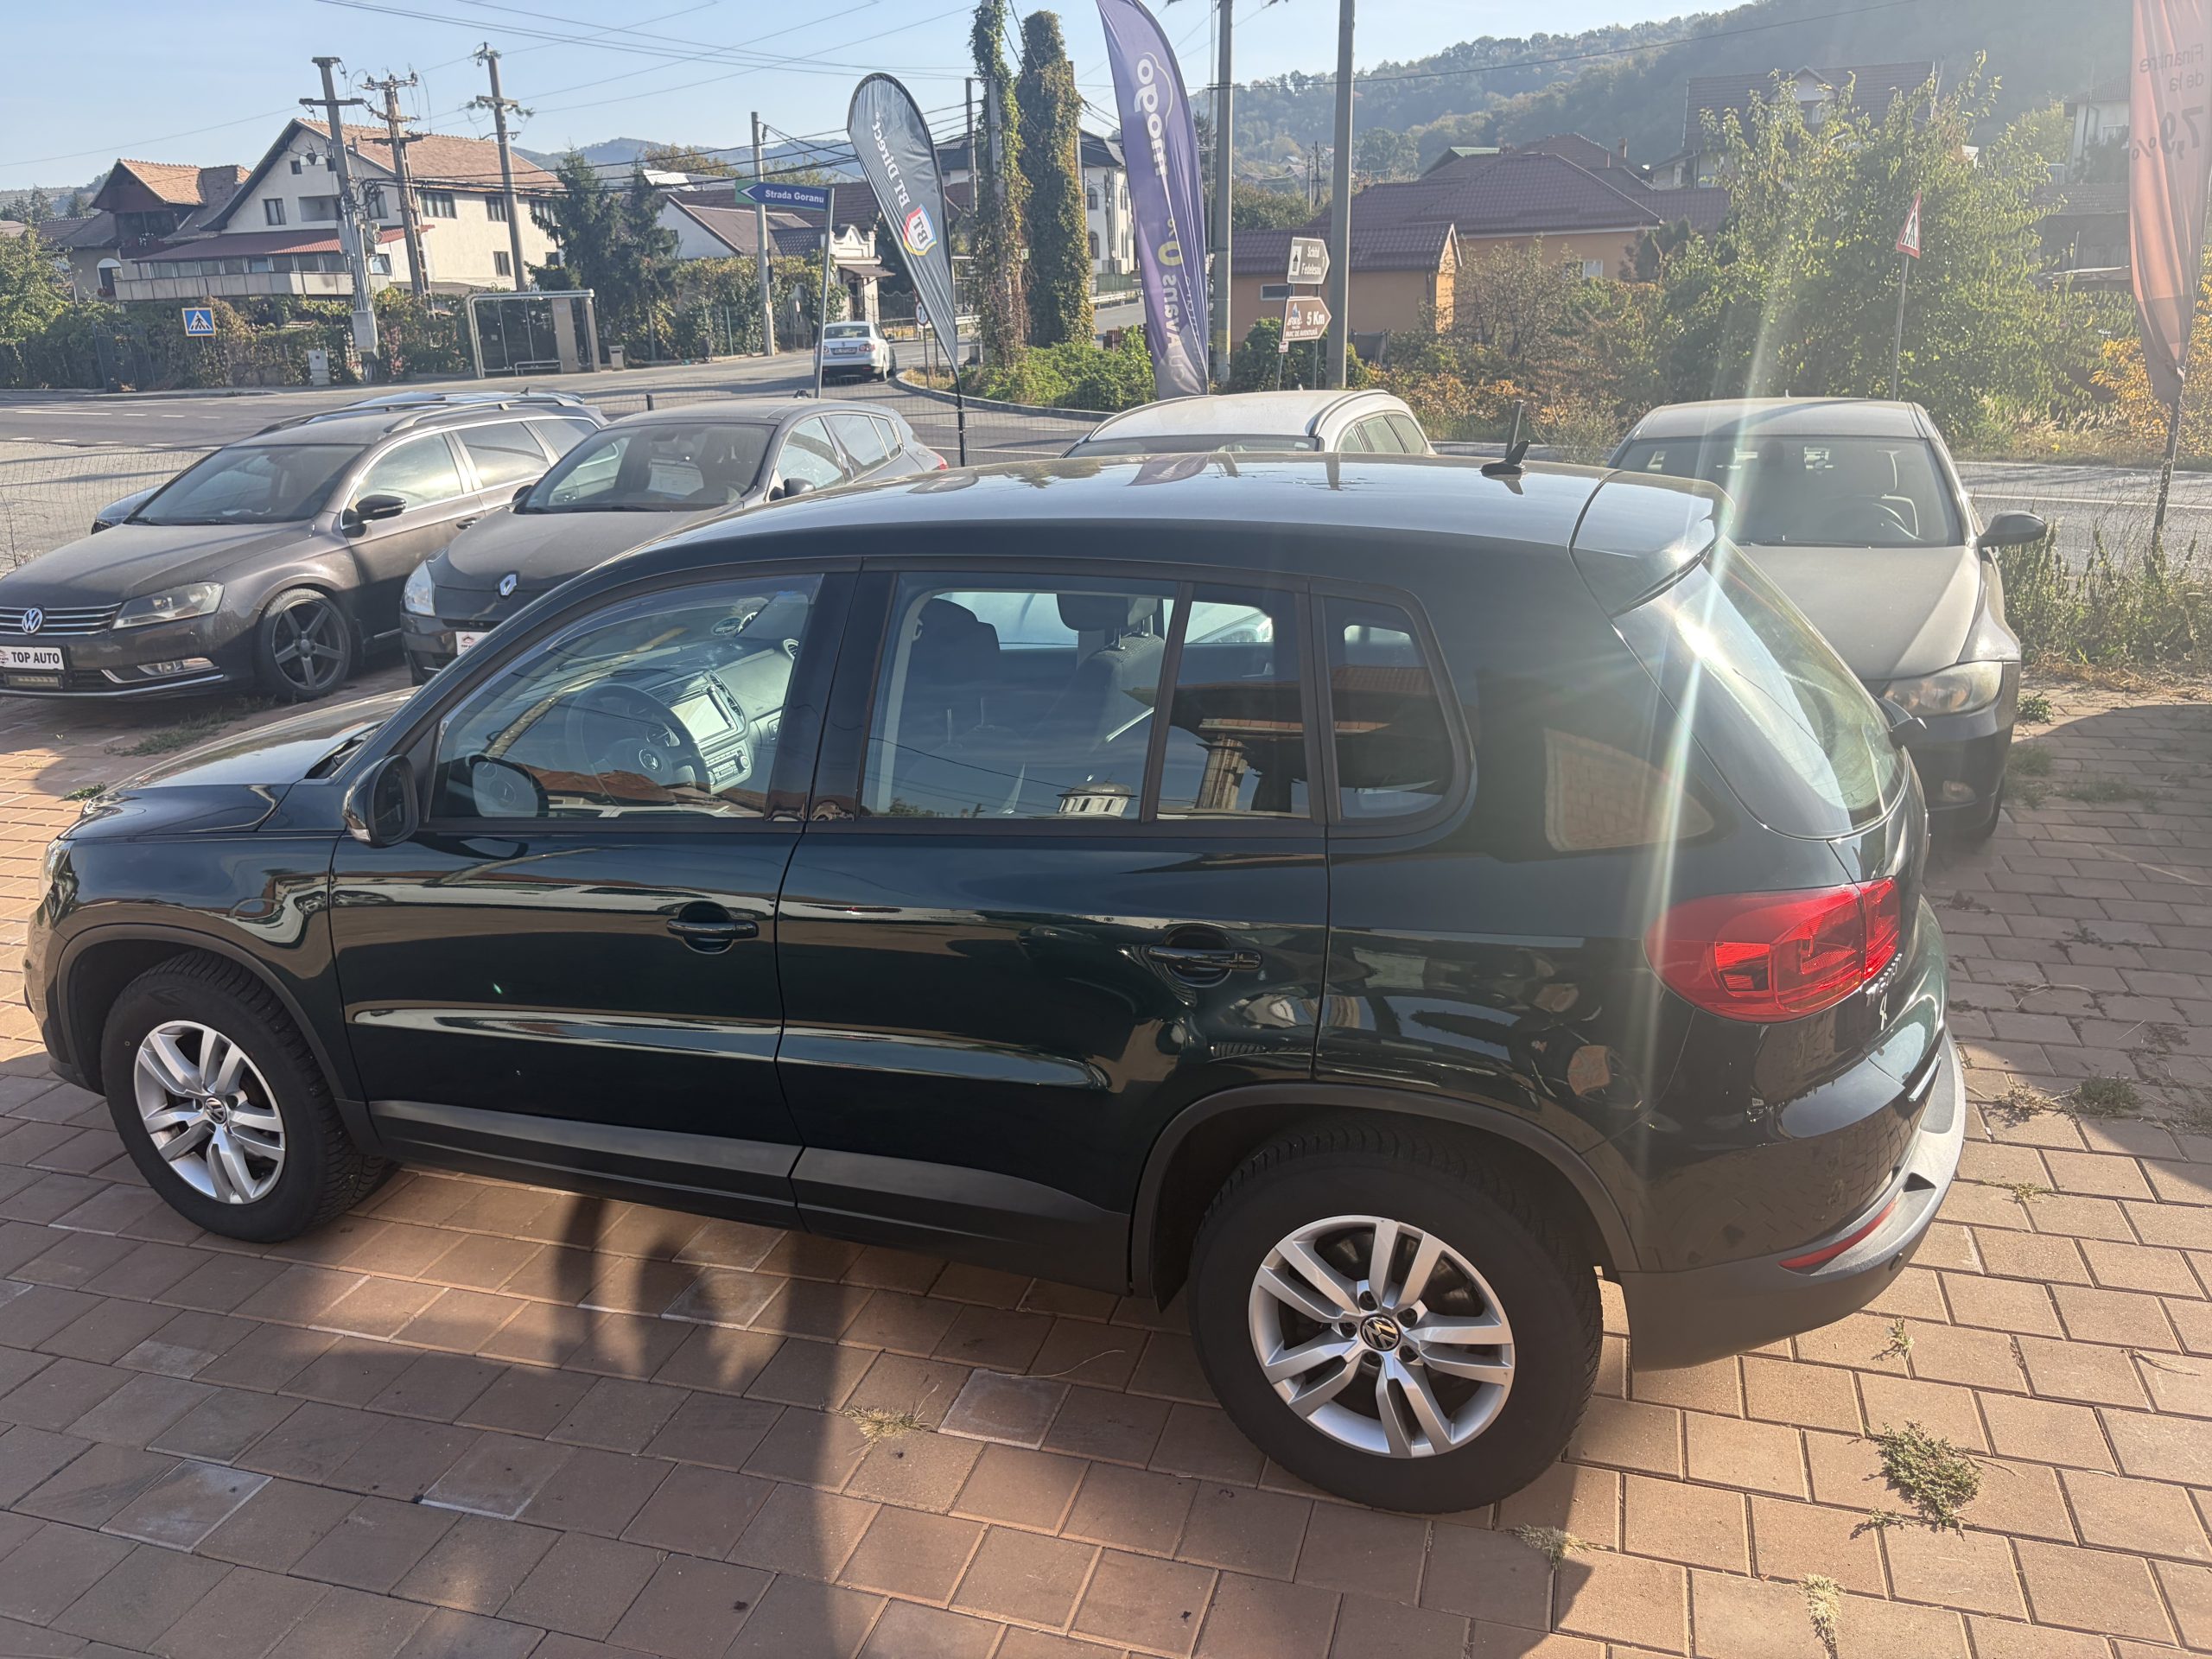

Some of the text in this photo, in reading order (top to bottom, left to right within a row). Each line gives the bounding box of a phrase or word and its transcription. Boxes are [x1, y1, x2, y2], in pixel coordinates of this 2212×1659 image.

[765, 189, 824, 204] Strada Goranu
[1306, 311, 1313, 326] 5
[1313, 311, 1325, 325] Km
[11, 652, 31, 664] TOP
[33, 652, 60, 664] AUTO
